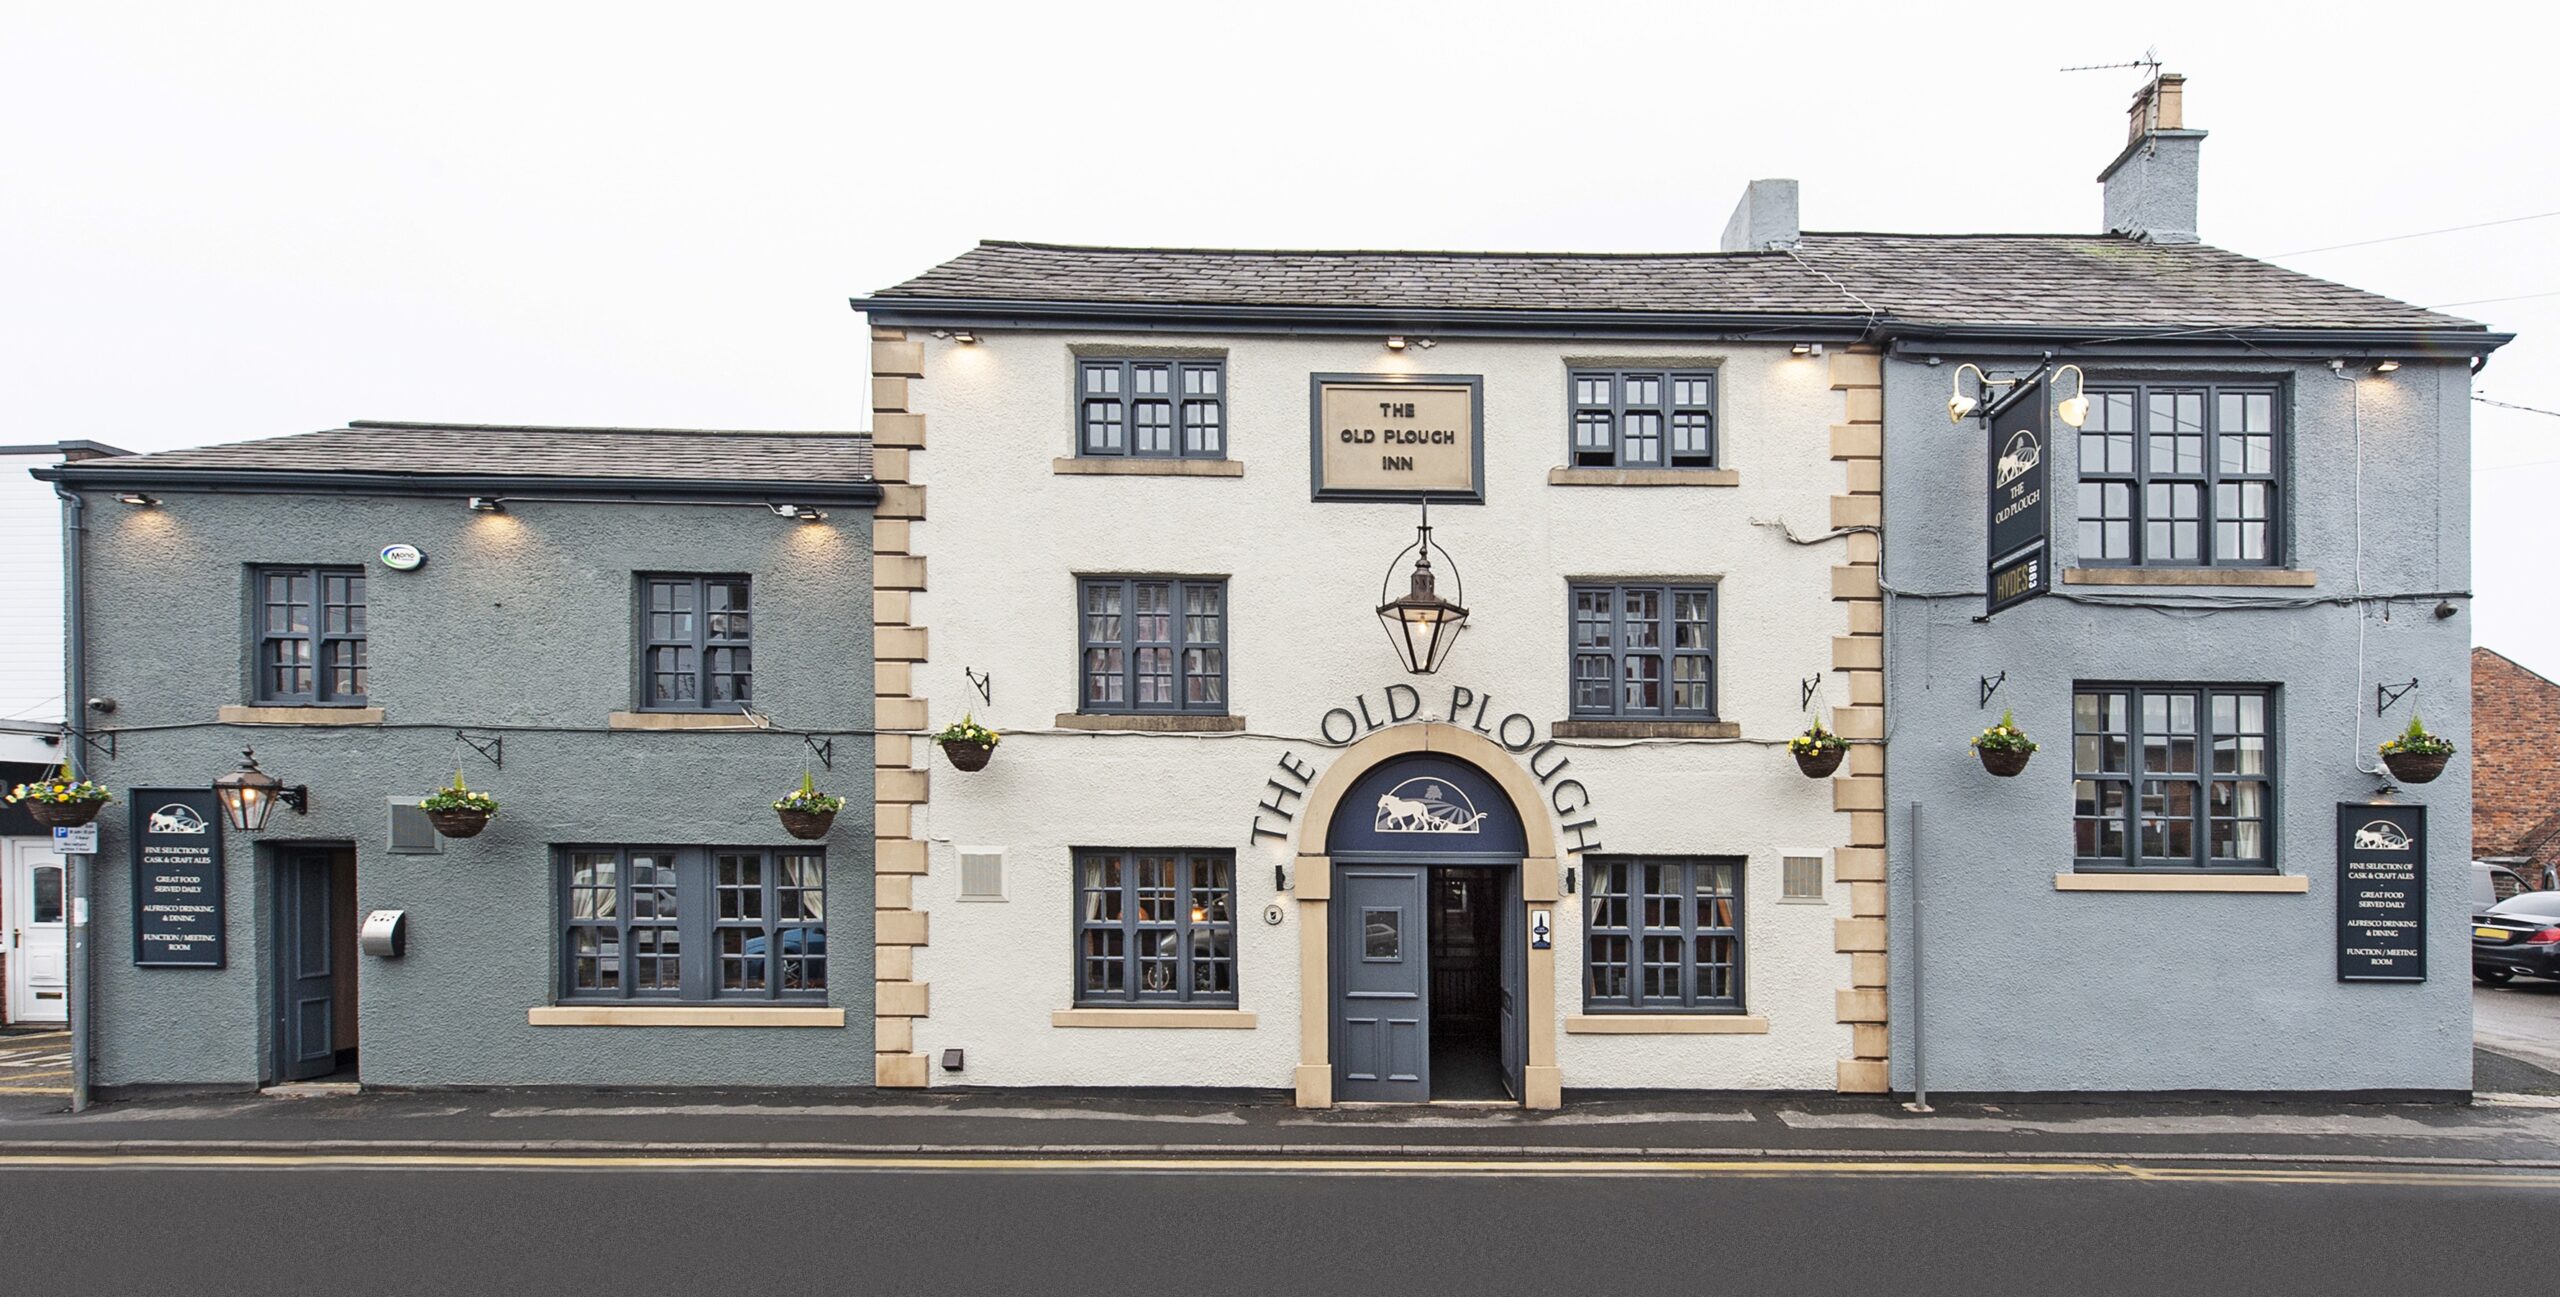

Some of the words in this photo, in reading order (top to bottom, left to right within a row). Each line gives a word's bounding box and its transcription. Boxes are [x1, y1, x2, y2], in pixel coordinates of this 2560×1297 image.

[1380, 402, 1415, 418] THE
[1340, 428, 1376, 444] OLD
[1384, 429, 1455, 445] PLOUGH
[1382, 456, 1414, 471] INN
[2010, 482, 2024, 499] THE
[1995, 508, 2011, 524] OLD
[2010, 489, 2040, 517] PLOUGH
[1996, 563, 2029, 602] HYDES
[2028, 560, 2038, 589] 1863
[1250, 750, 1316, 847] THE
[1320, 682, 1422, 745] OLD
[1448, 684, 1603, 855] PLOUGH
[145, 846, 161, 854] FINE
[162, 846, 199, 854] SELECTION
[200, 846, 210, 854] OF
[2350, 862, 2366, 870] FINE
[2367, 862, 2403, 870] SELECTION
[2404, 862, 2414, 870] OF
[144, 934, 179, 942] FUNCTION
[184, 934, 216, 942] MEETING
[2346, 948, 2382, 956] FUNCTION
[2386, 948, 2418, 956] MEETING
